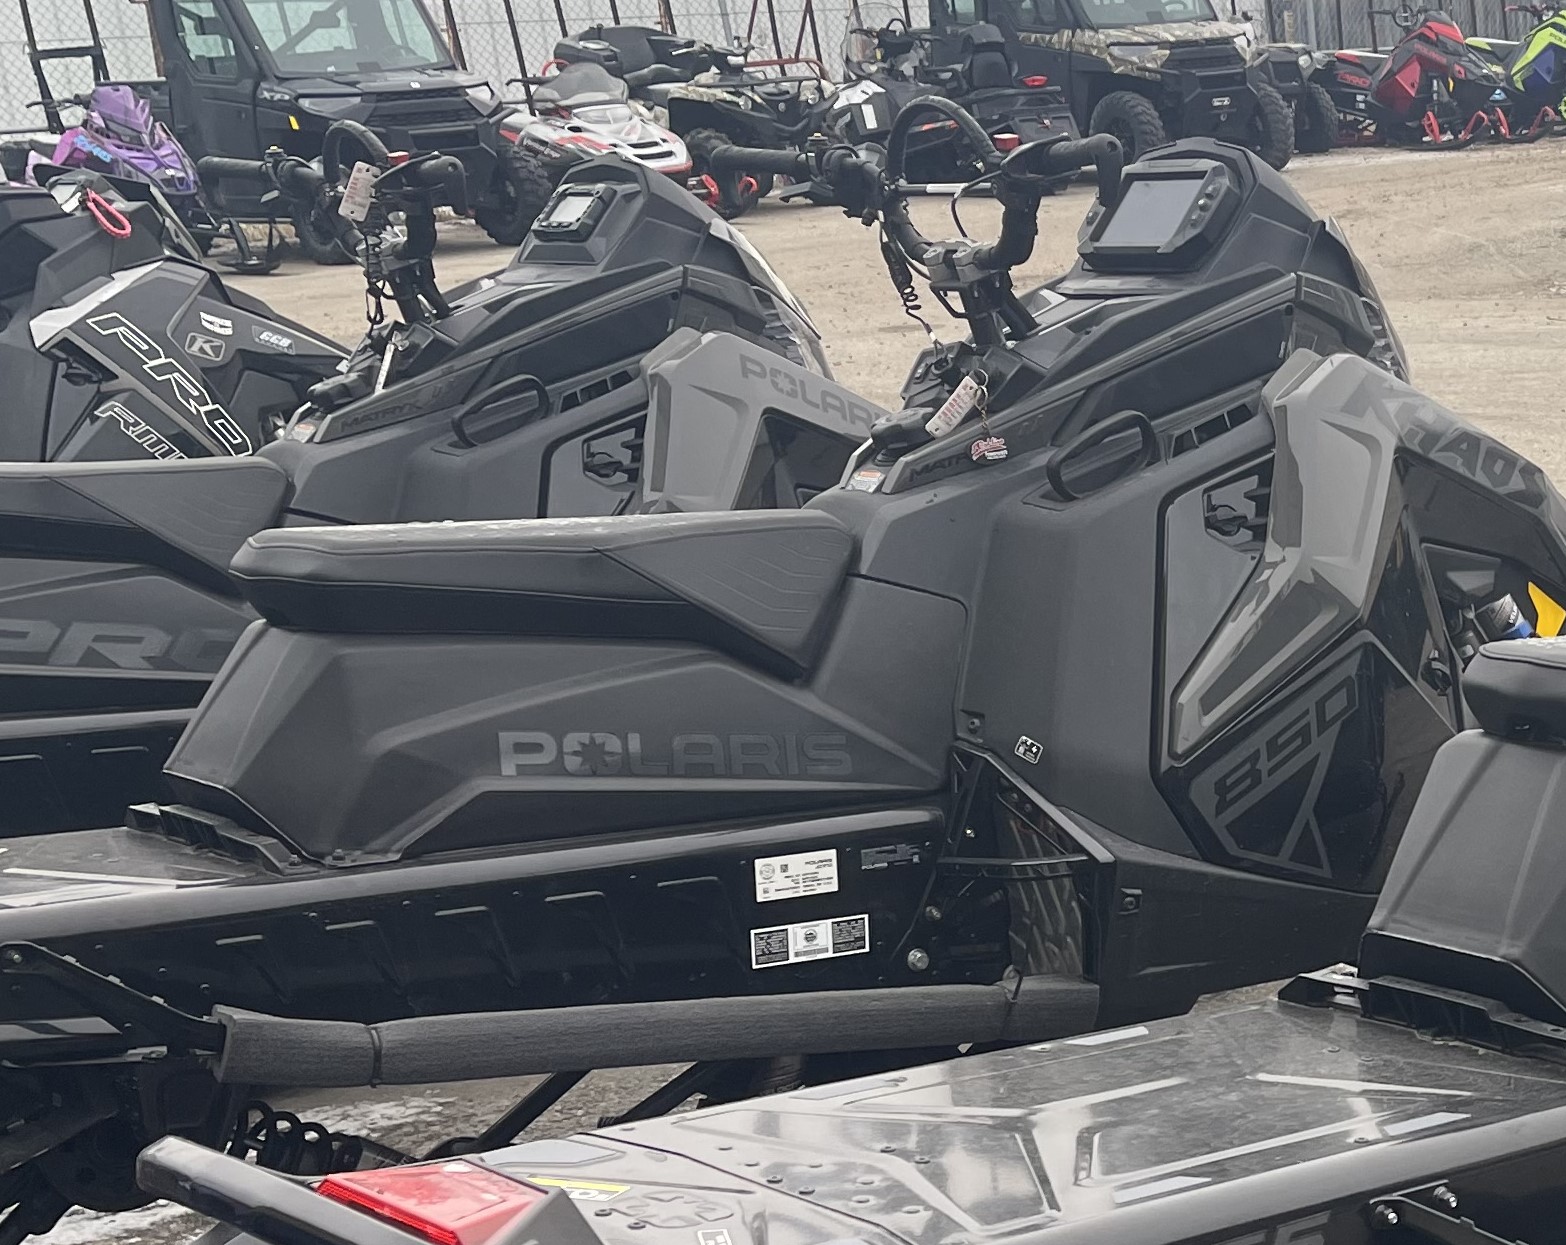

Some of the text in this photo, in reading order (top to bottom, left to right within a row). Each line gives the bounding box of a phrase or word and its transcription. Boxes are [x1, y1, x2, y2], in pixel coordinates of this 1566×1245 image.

[86, 312, 253, 458] PRO
[1340, 366, 1548, 510] KHAOS
[498, 731, 853, 776] POLARIS
[1213, 675, 1359, 821] 850
